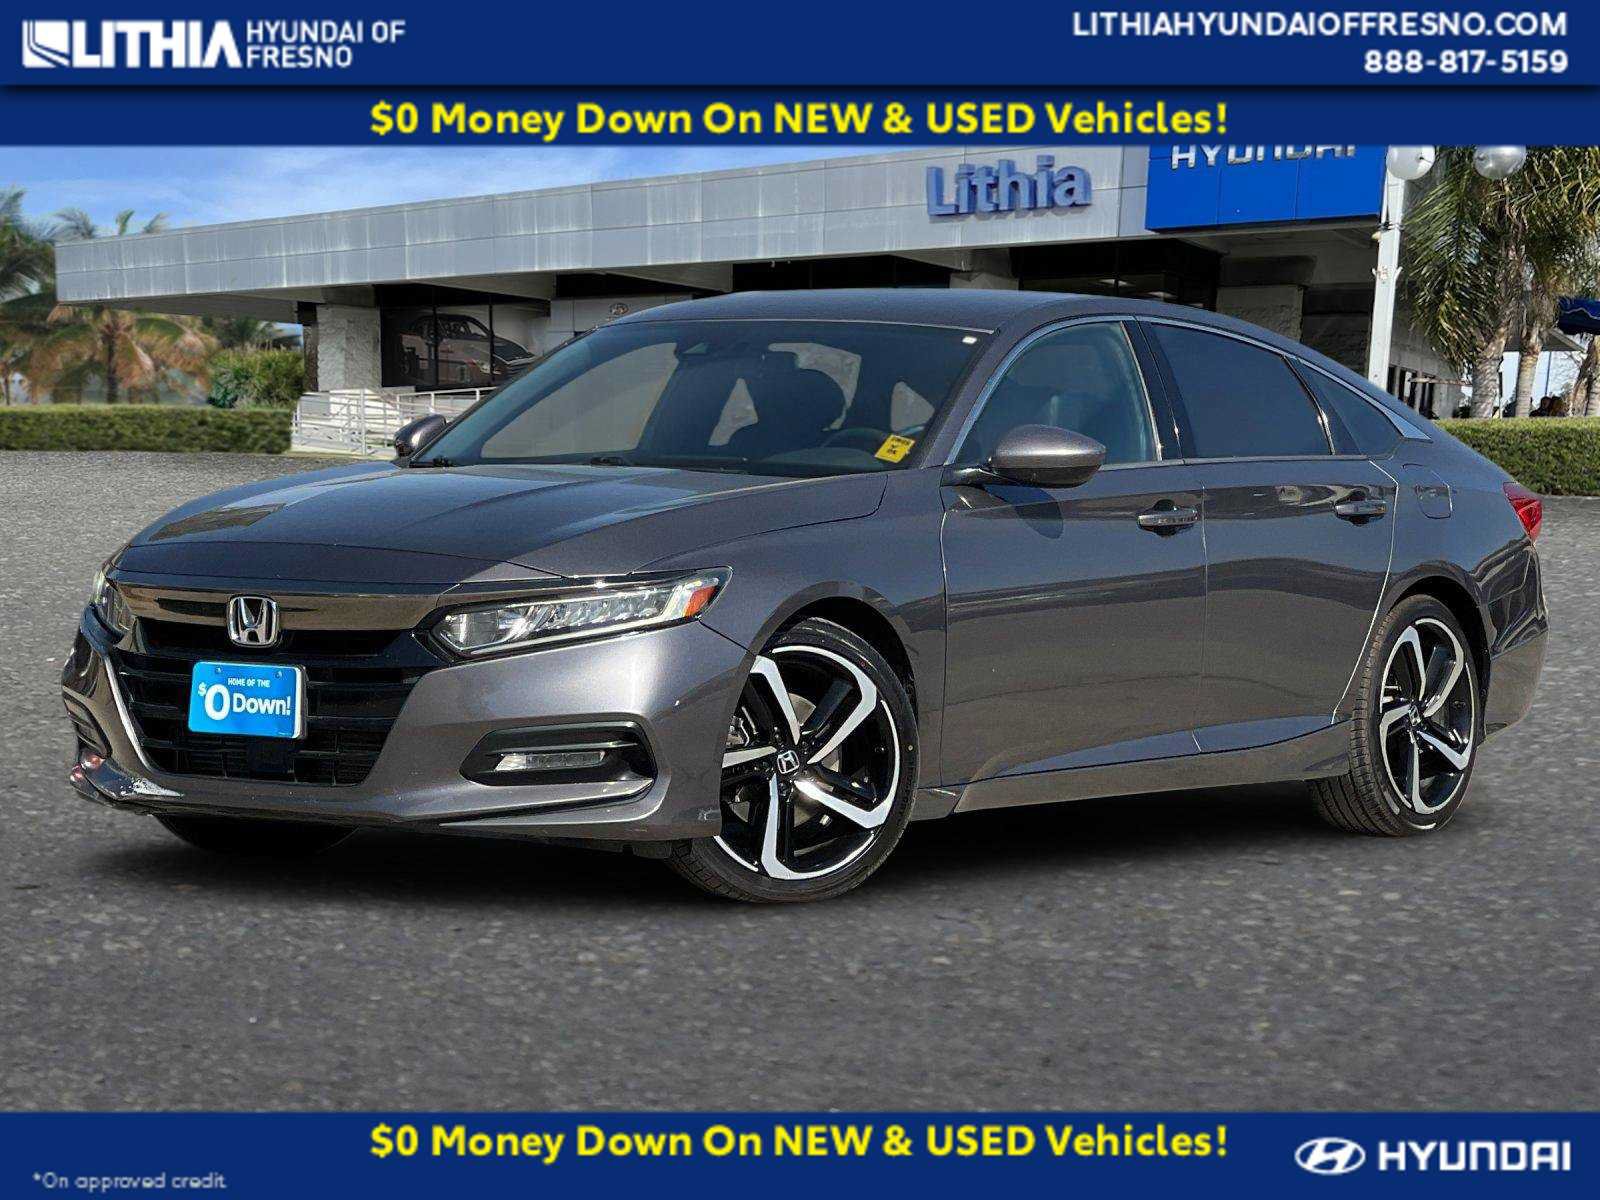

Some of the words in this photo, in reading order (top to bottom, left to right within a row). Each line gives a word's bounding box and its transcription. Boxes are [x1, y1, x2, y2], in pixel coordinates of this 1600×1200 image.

[926, 154, 1092, 216] Lithia
[227, 677, 245, 686] HOME
[257, 679, 271, 688] THE
[232, 693, 291, 716] Down!
